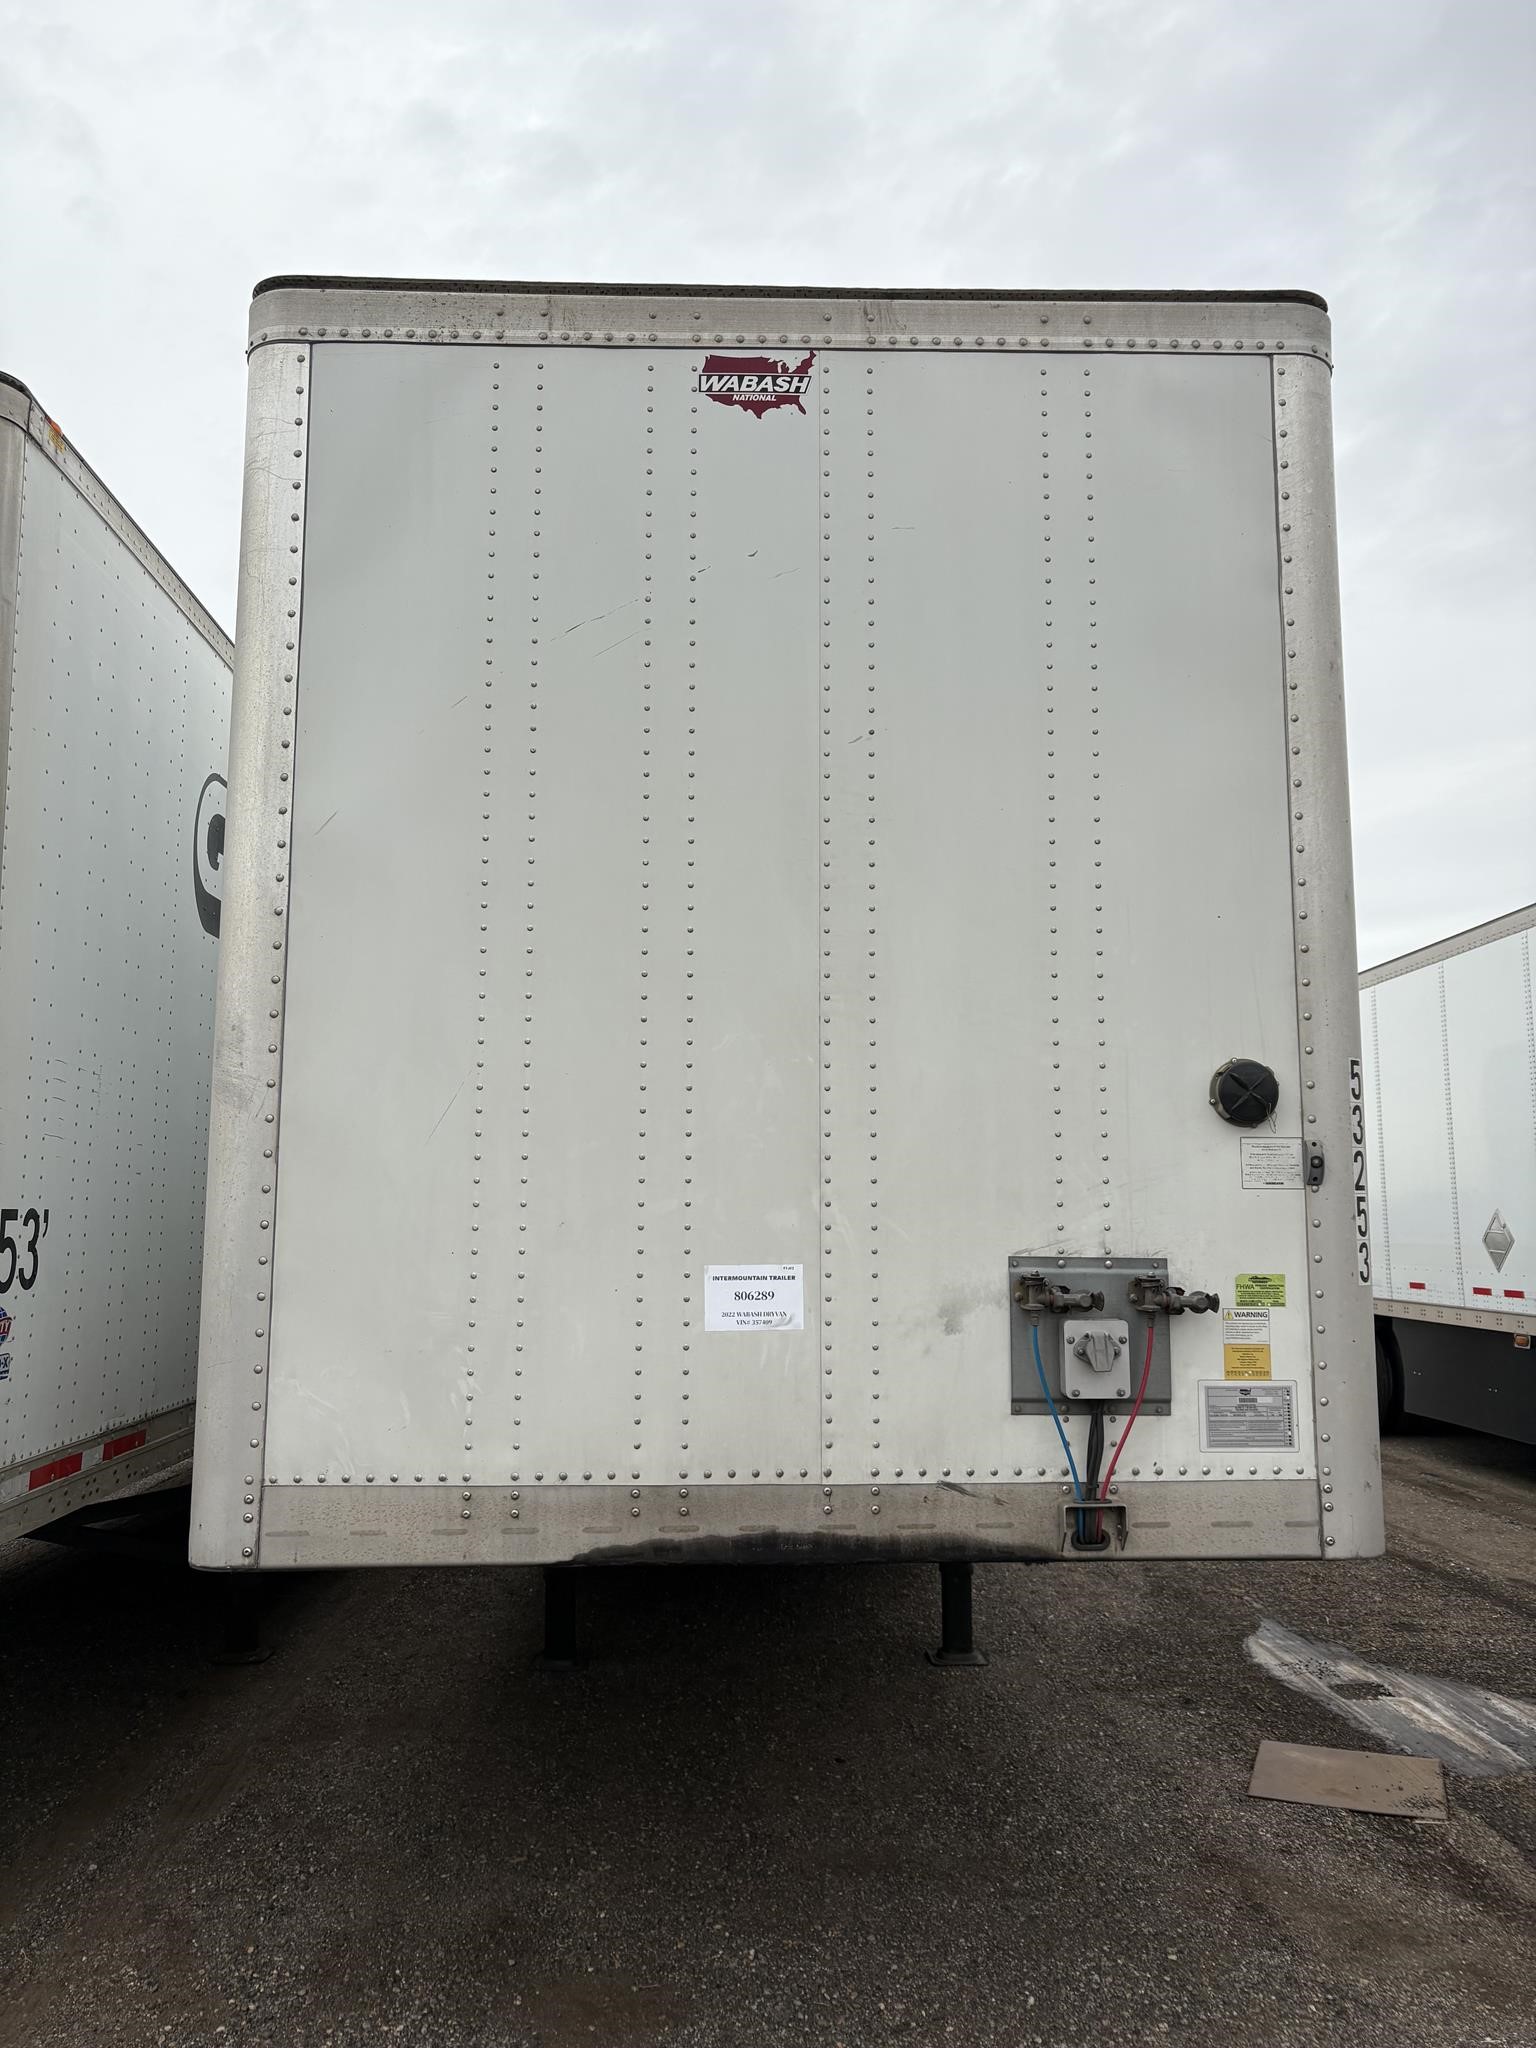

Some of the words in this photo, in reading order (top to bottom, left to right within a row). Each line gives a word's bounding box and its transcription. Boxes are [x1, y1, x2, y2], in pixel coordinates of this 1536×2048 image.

[700, 375, 810, 393] WABASH
[732, 394, 777, 402] NATIONAL
[1350, 1059, 1370, 1283] 53253
[734, 1290, 775, 1301] 806289
